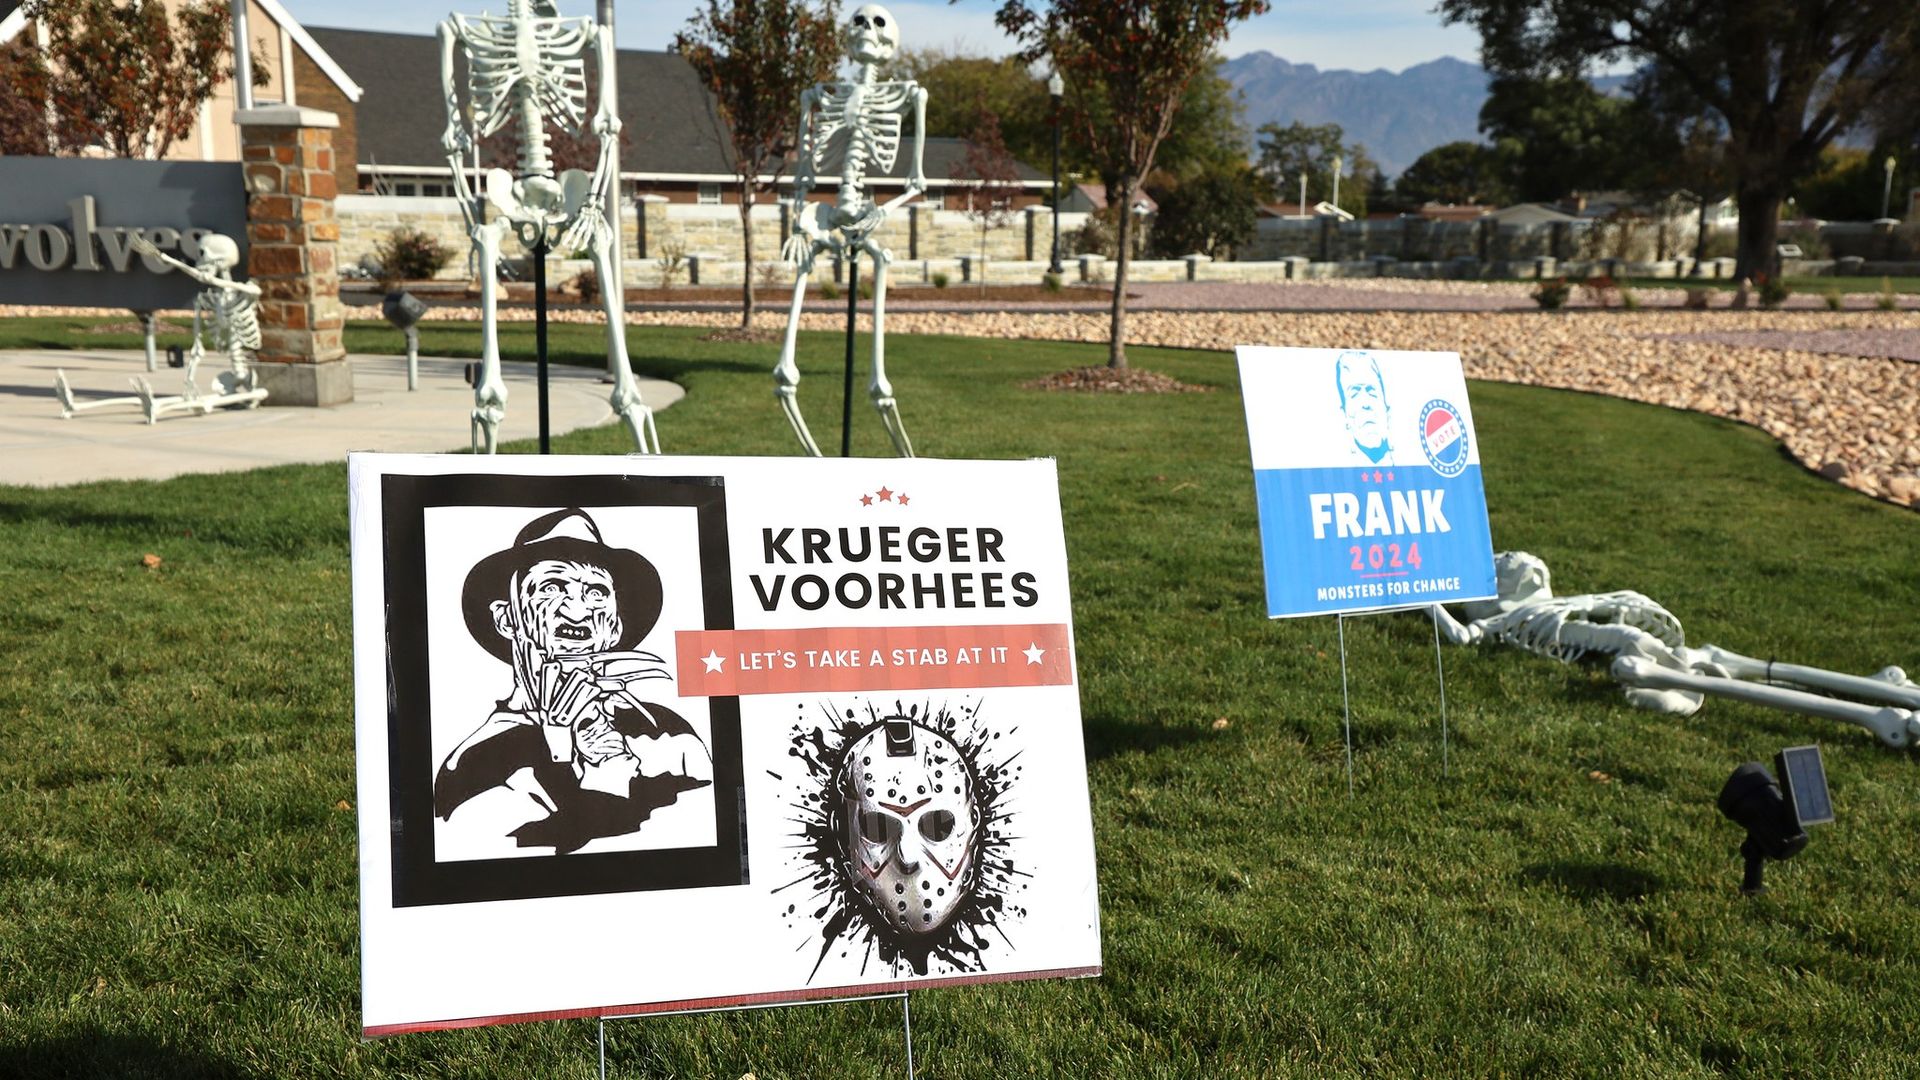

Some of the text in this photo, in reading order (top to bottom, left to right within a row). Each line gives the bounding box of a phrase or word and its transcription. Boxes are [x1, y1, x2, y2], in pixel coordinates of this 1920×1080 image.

[1433, 425, 1456, 448] VOTE
[1309, 489, 1452, 540] FRANK
[763, 526, 1005, 563] KRUEGER
[1350, 542, 1422, 571] 2024
[750, 572, 1038, 611] VOORHEES
[1317, 576, 1461, 601] MONSTERS FOR CHANGE
[804, 649, 861, 668] TAKE
[869, 648, 885, 667] A
[892, 648, 948, 667] STAB
[955, 647, 982, 664] AT
[991, 646, 1009, 664] IT
